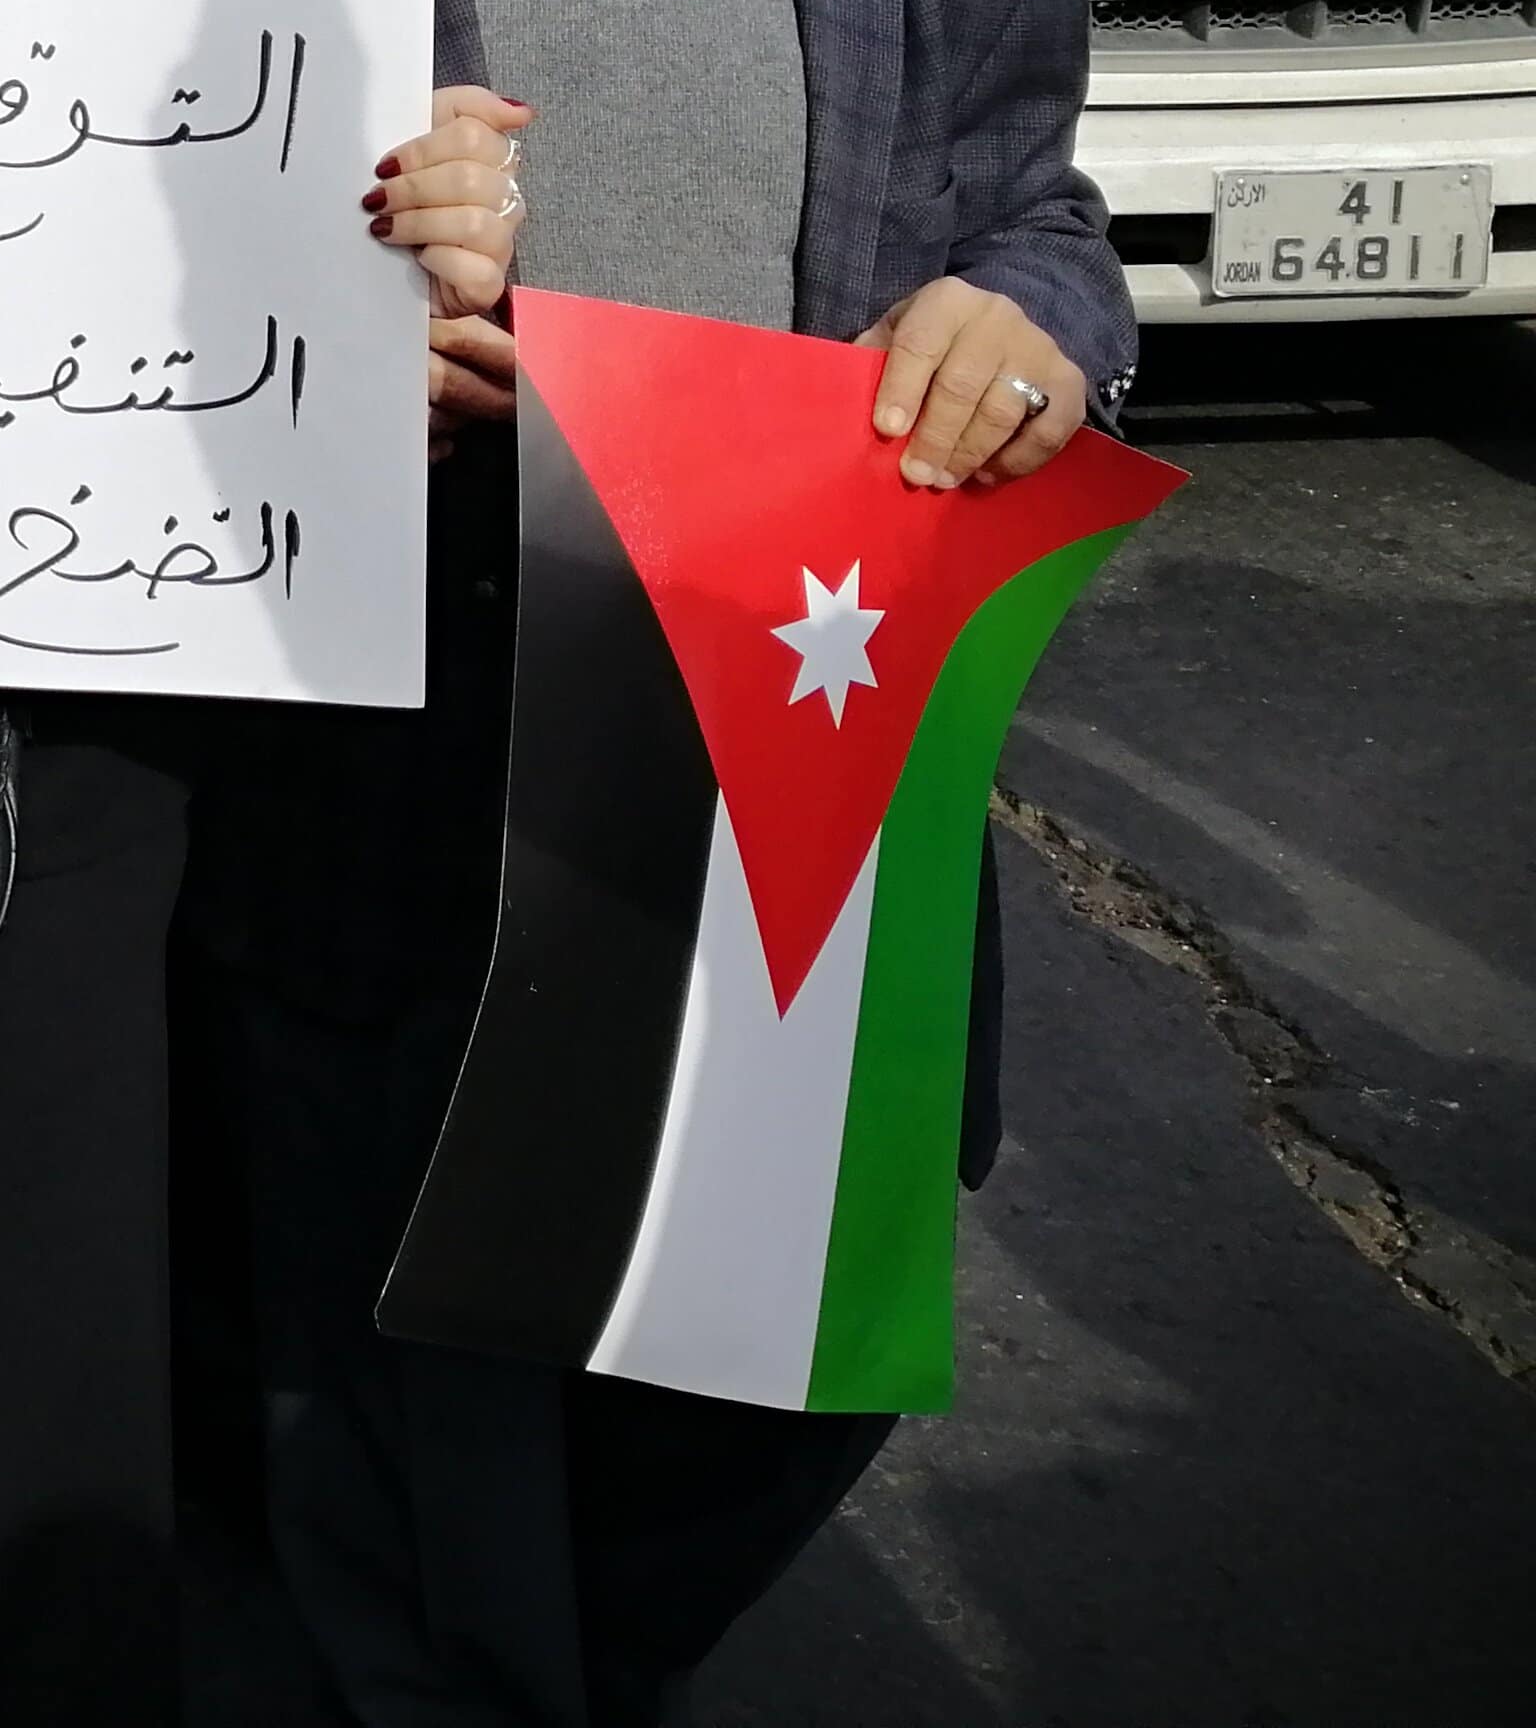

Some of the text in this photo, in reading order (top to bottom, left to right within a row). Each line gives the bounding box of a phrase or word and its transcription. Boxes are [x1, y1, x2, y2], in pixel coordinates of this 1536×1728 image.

[1339, 180, 1404, 225] 41
[1224, 262, 1261, 283] JORDAN
[1272, 234, 1463, 281] 64811
